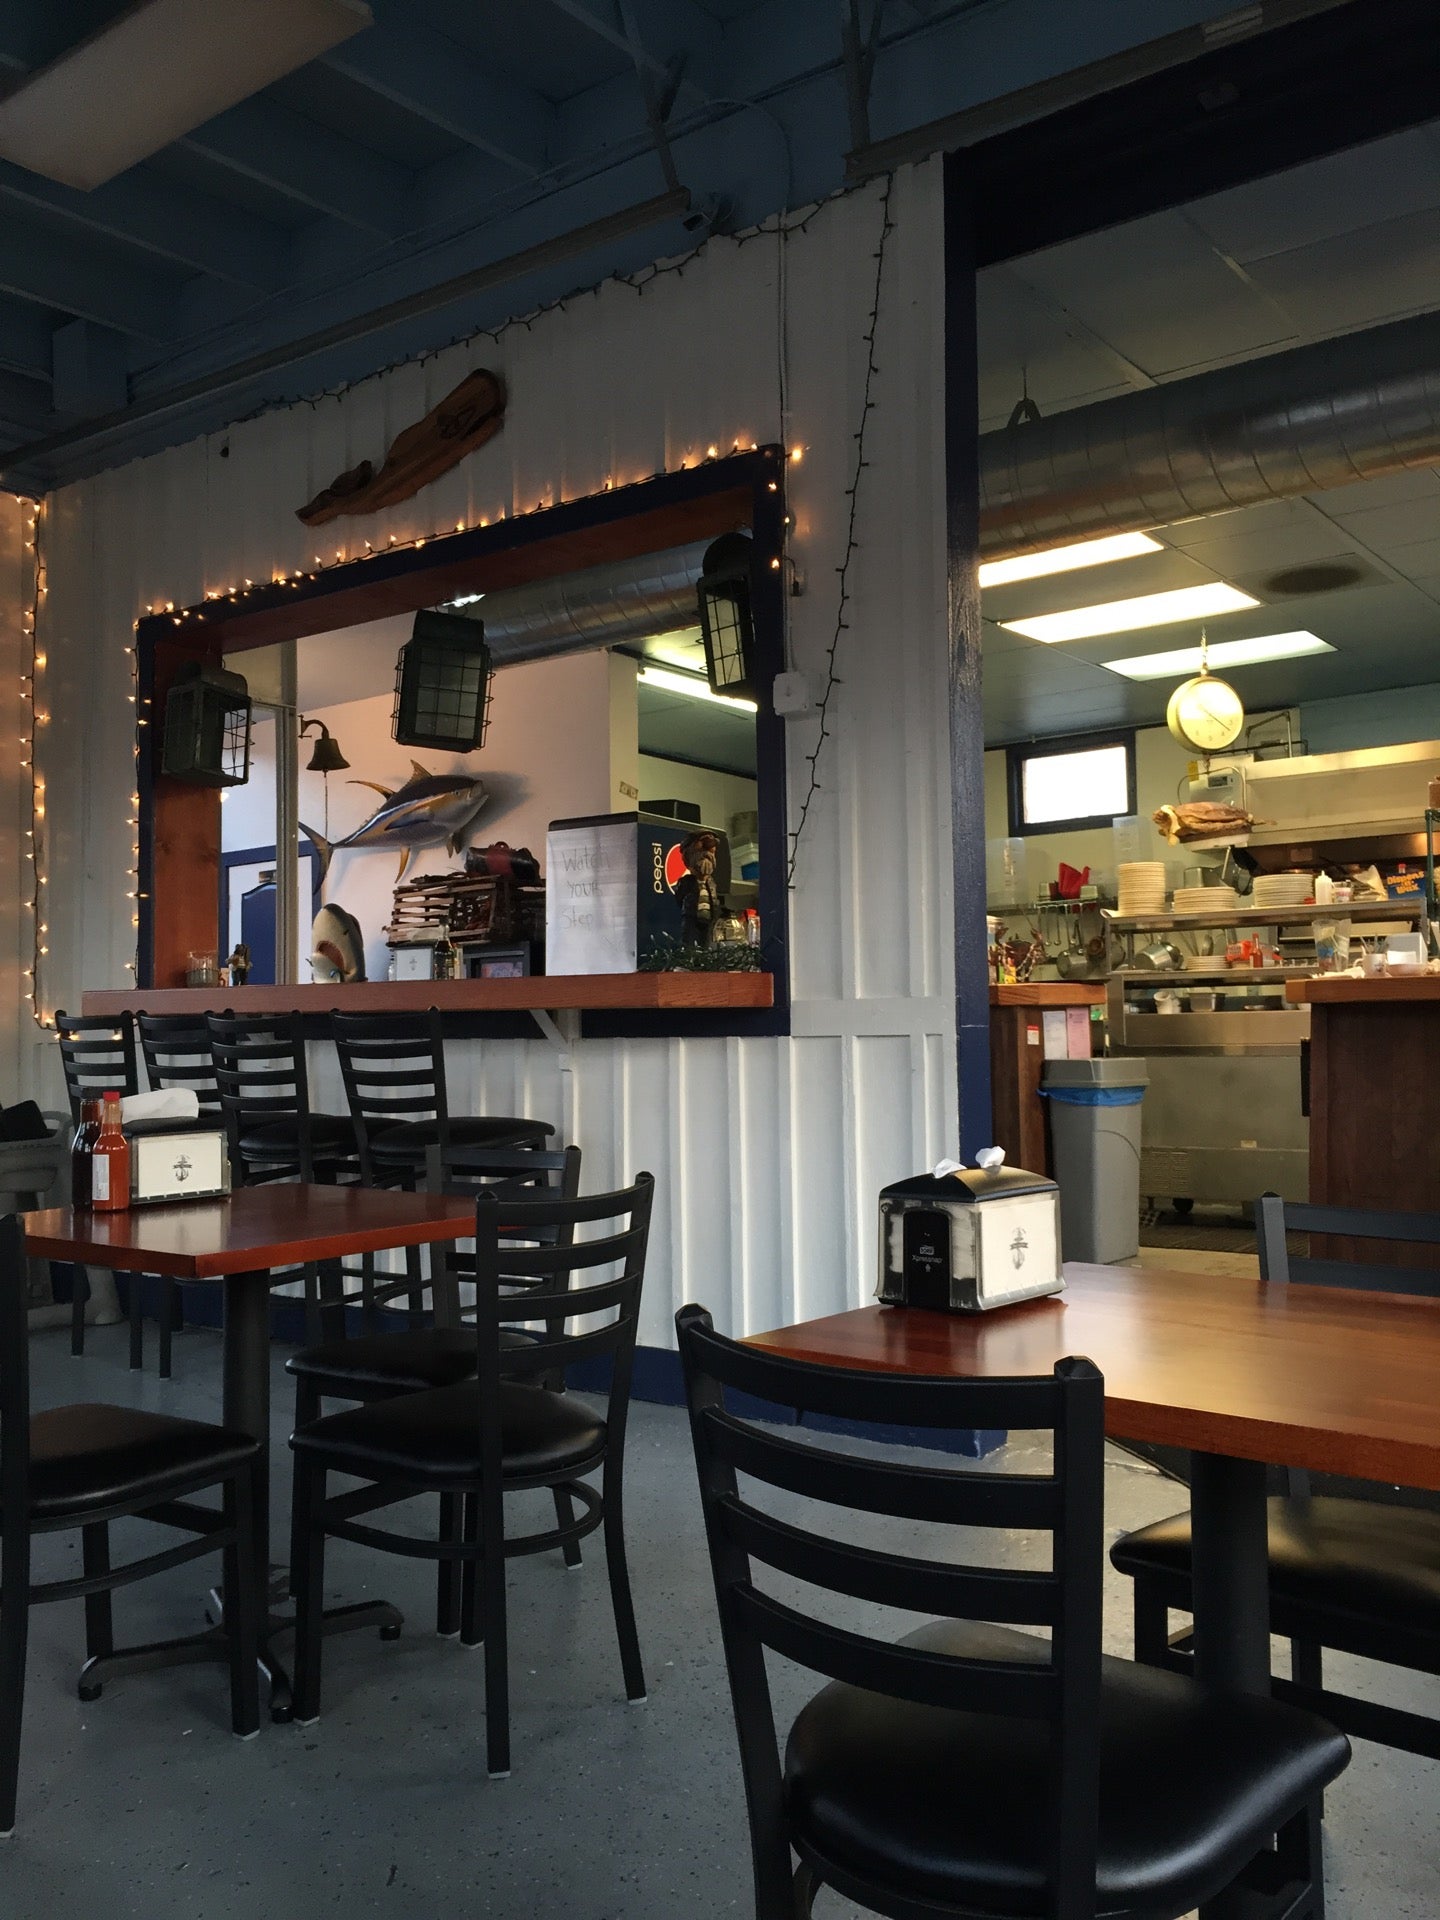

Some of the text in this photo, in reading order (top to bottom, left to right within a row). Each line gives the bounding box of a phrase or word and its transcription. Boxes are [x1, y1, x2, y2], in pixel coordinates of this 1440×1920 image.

[561, 845, 610, 872] Watch
[651, 842, 664, 895] pepsi
[562, 905, 594, 932] Step
